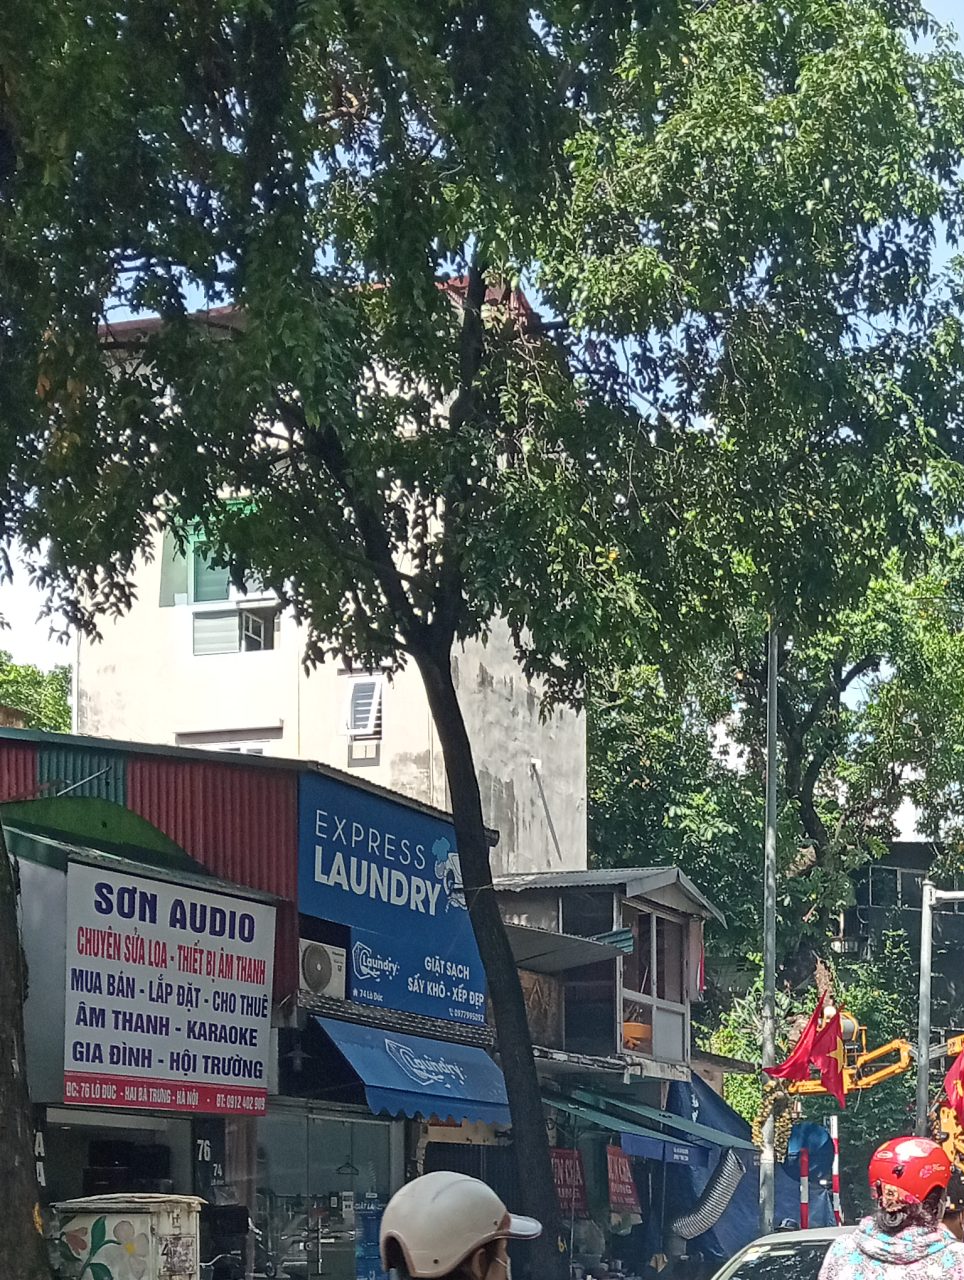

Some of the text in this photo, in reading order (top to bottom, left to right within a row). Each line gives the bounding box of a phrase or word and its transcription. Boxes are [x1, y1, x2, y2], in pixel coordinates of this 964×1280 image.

[315, 809, 426, 870] EXPRESS
[314, 845, 442, 917] LAUNDRY
[94, 882, 255, 943] SƠN AUDIO
[77, 925, 266, 985] CHUYÊN SỬA LOA THIẾT BỊ ÂM THANH
[363, 954, 398, 976] Laundry
[424, 955, 470, 980] GIẶT SẠCH
[70, 967, 269, 1018] MUA BÁN LẮP ĐẶT CHO THUÊ
[407, 973, 485, 1009] SẤY KHÔ XẾP ĐẸP
[75, 1001, 258, 1047] ÂM THANH KARAOKE
[72, 1041, 264, 1079] GIA ĐÌNH HỘI TRƯỜNG
[404, 1054, 466, 1082] Laundry
[80, 1082, 90, 1098] 76
[196, 1139, 211, 1161] 76
[212, 1163, 223, 1177] 74
